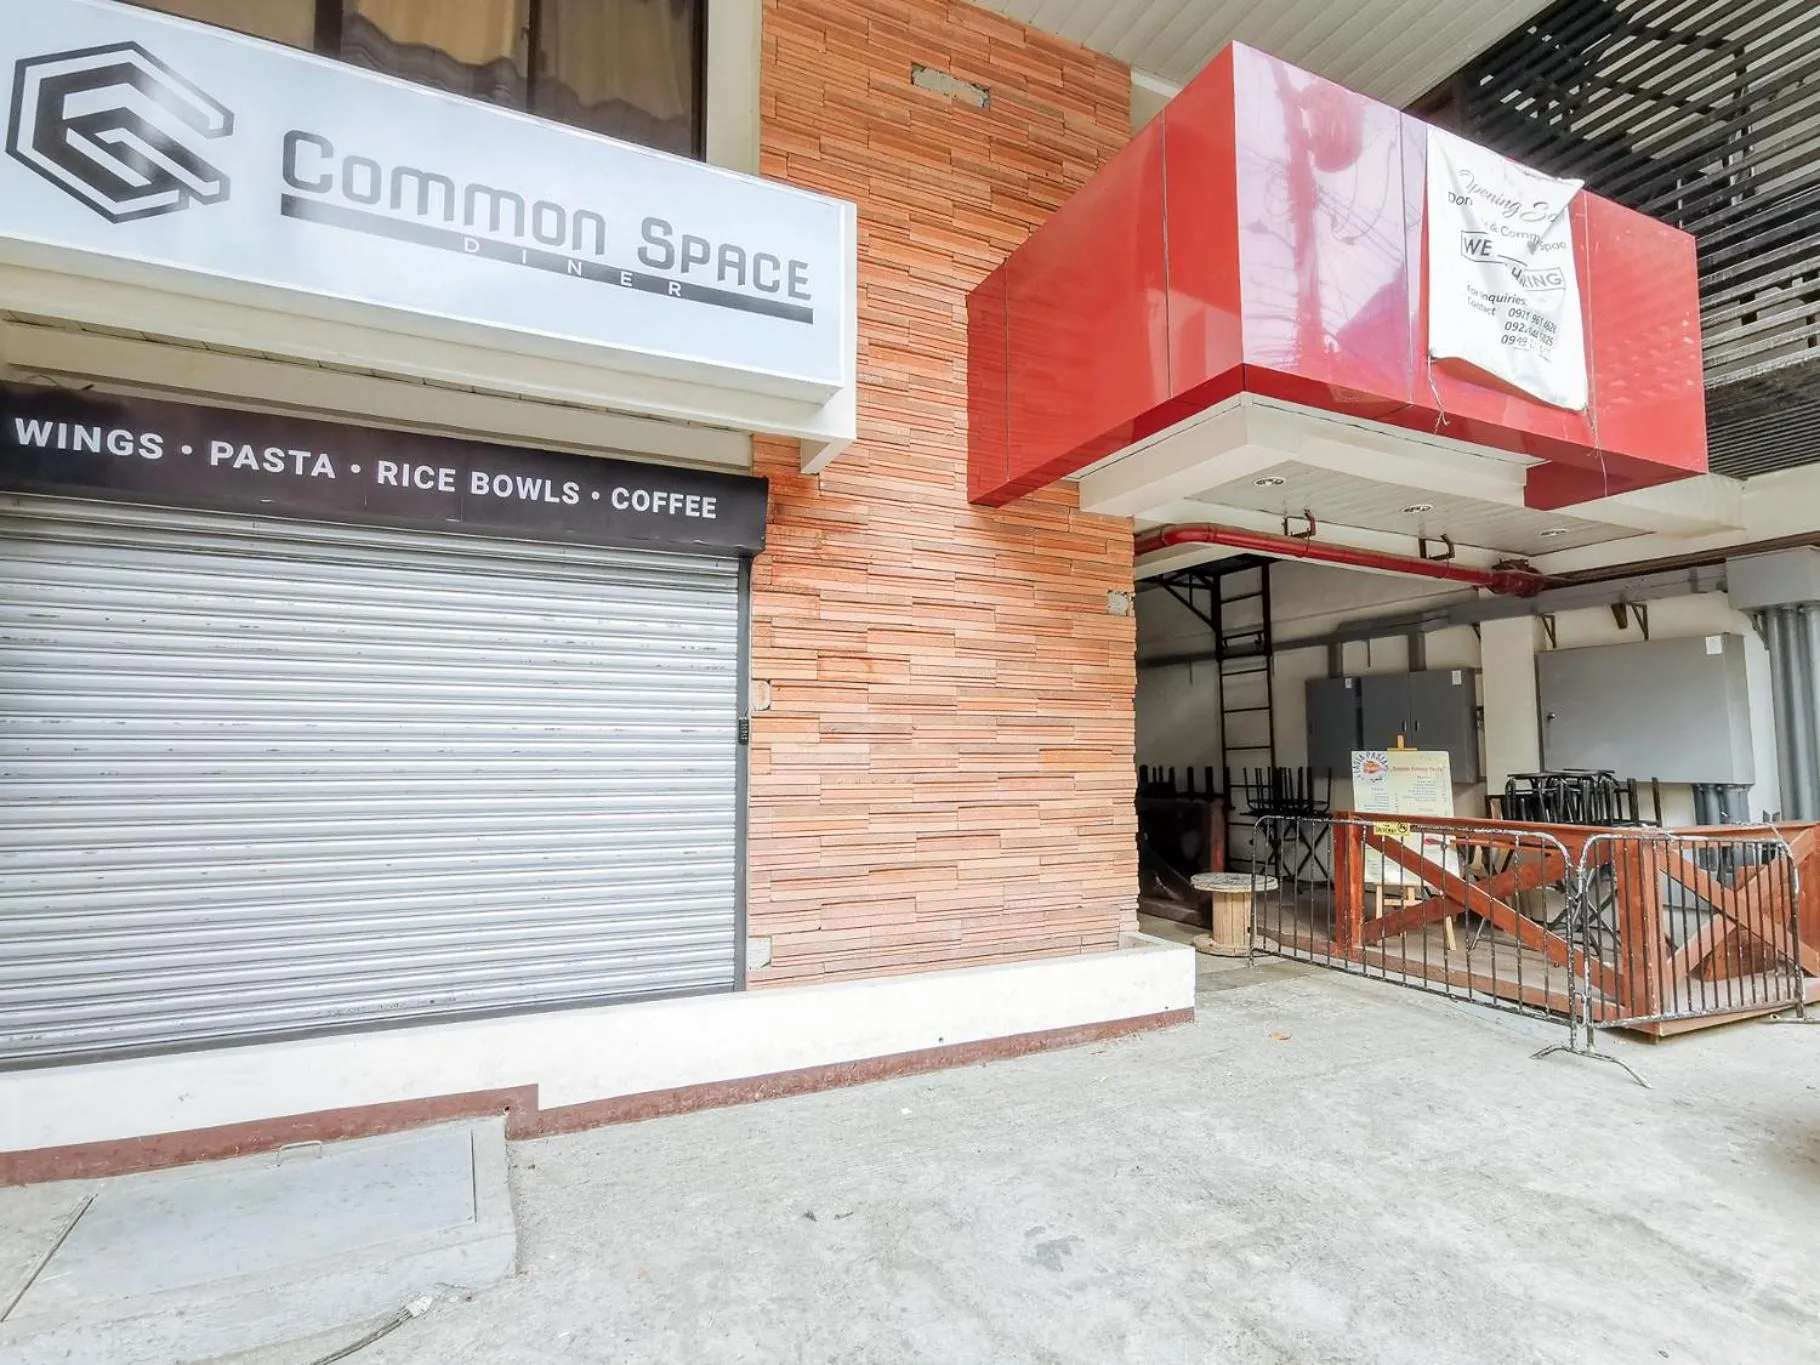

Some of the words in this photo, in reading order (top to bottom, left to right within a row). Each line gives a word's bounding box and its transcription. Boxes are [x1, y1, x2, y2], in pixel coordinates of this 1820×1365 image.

[463, 235, 682, 298] DINER
[1463, 238, 1493, 256] WE
[14, 417, 165, 460] WINGS
[209, 440, 337, 479] PASTA
[377, 460, 457, 493] RICE
[470, 471, 580, 505] BOWLS
[611, 486, 718, 520] COFFEE
